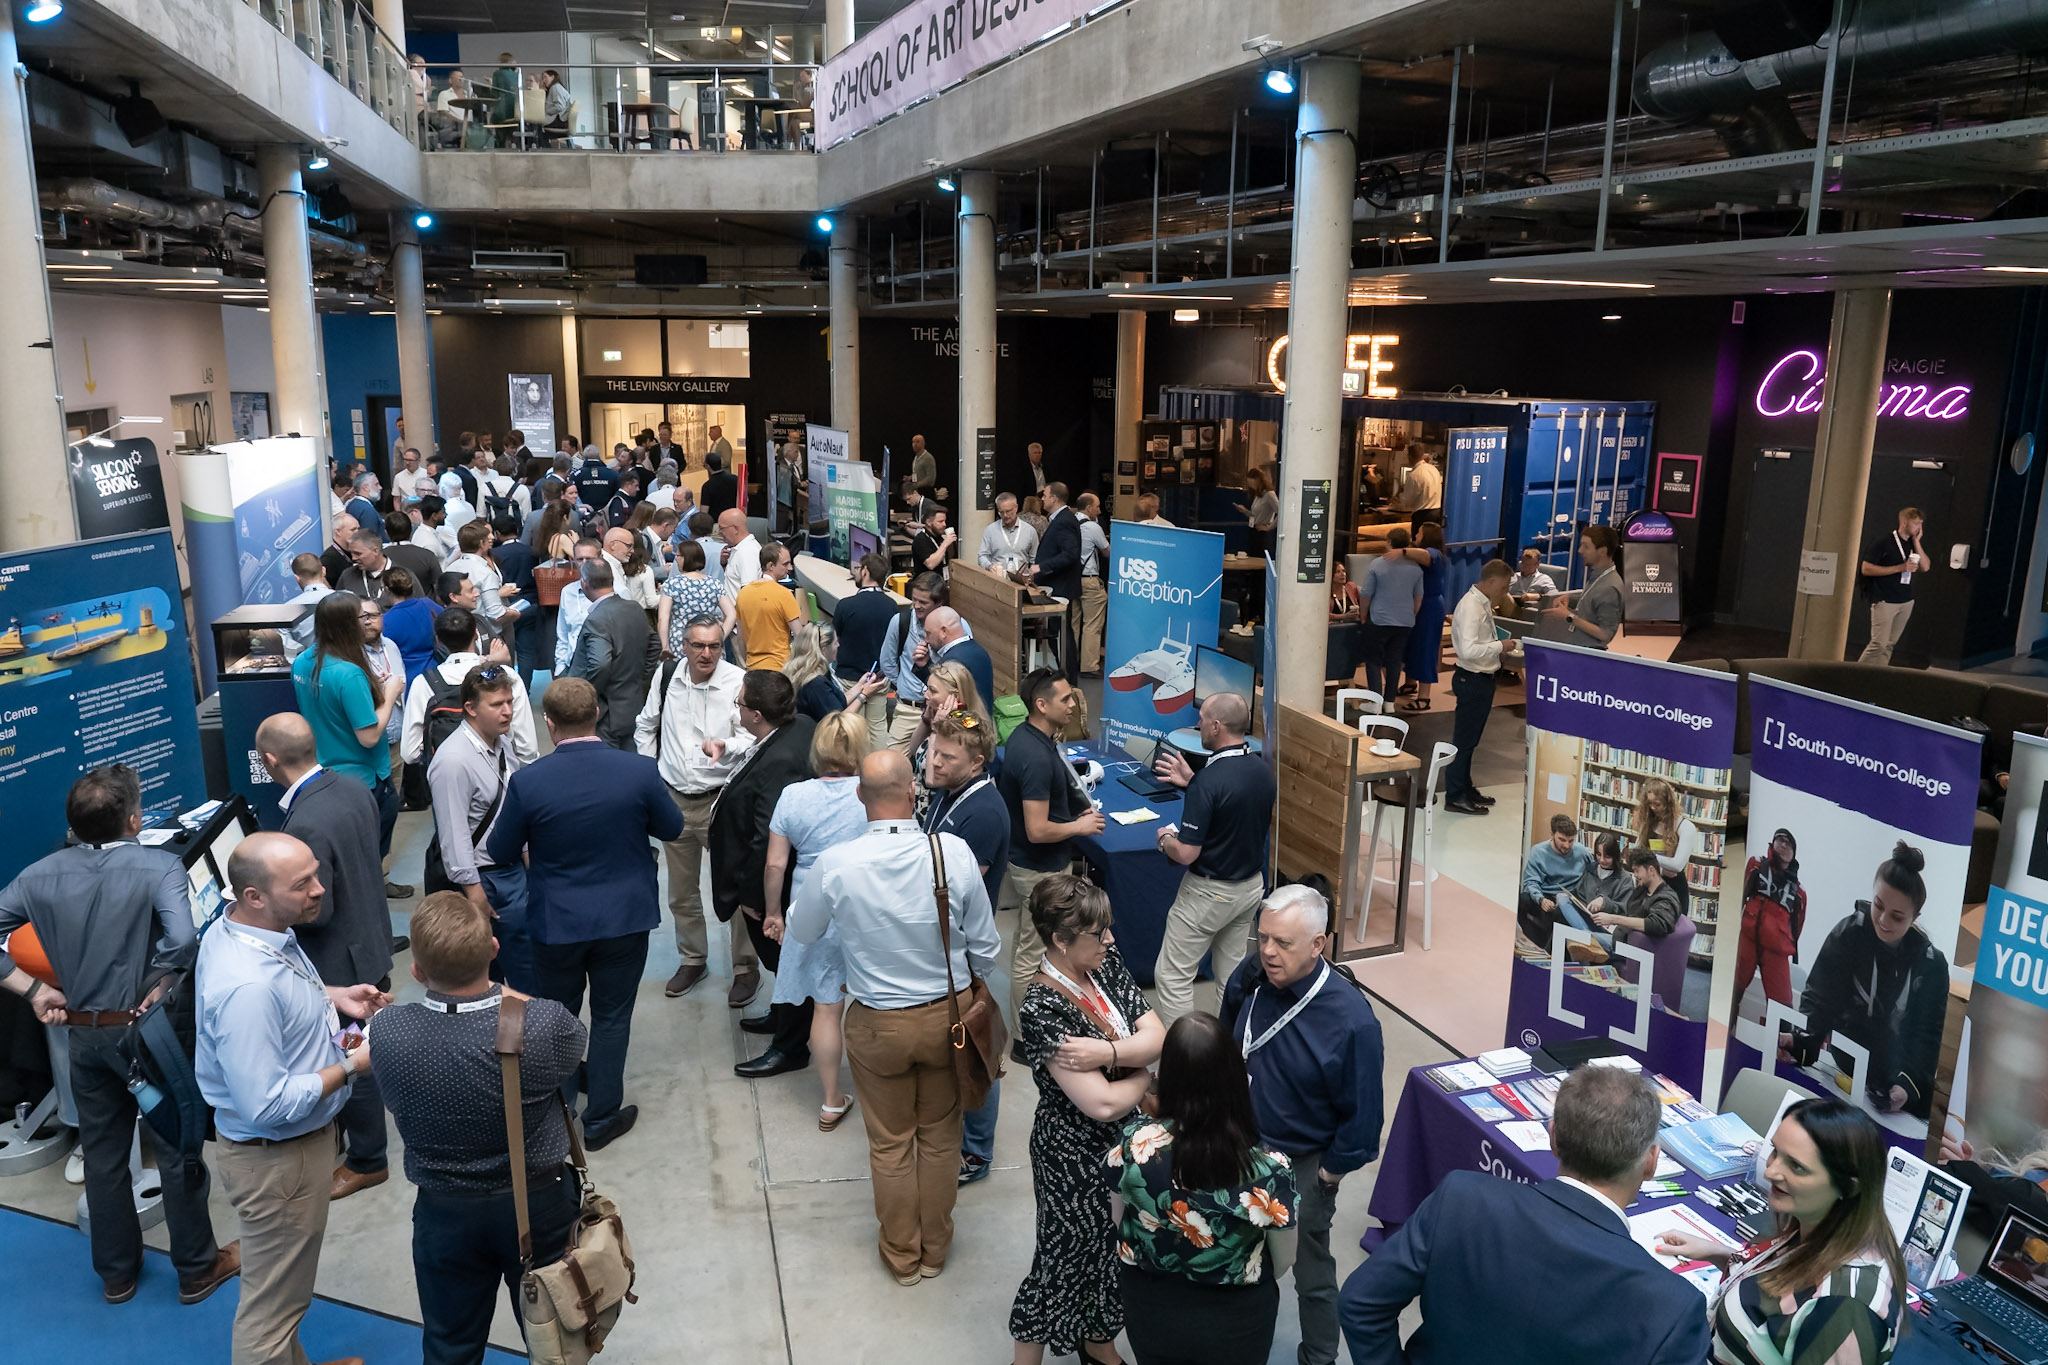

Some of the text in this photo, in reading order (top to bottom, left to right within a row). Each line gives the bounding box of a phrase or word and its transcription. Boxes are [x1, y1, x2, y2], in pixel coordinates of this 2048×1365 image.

[829, 46, 892, 122] SCHOOL
[896, 24, 922, 82] OF
[927, 0, 964, 67] ART
[911, 327, 940, 341] THE
[1267, 335, 1399, 397] CFE
[1883, 358, 1946, 375] RAIGIE
[606, 380, 730, 392] THE LEVINSKY GALLERY
[1756, 350, 1971, 419] Cima
[810, 435, 844, 457] AutoNaut
[91, 458, 135, 481] SILICON
[103, 492, 152, 511] SUPERIOR SENSORS
[836, 496, 862, 508] MARINE
[829, 505, 875, 521] AUTONOMOUS
[1628, 522, 1674, 537] Cinema
[91, 544, 155, 560] coastalautonomy.com
[1, 564, 30, 575] CENTRE
[1119, 556, 1158, 582] USS
[1118, 578, 1192, 606] inception
[1632, 586, 1673, 594] PLYMOUTH
[88, 685, 110, 694] integrated
[110, 678, 136, 689] autonomous
[4, 705, 38, 722] Centre
[1560, 685, 1713, 731] South Devon College
[82, 730, 102, 740] including
[1109, 728, 1118, 736] for
[1110, 718, 1123, 728] This
[1123, 723, 1148, 735] modular
[1149, 728, 1163, 739] USV
[23, 753, 40, 764] coastal
[41, 746, 66, 759] observing
[1787, 731, 1951, 797] South Devon College
[6, 768, 27, 780] network
